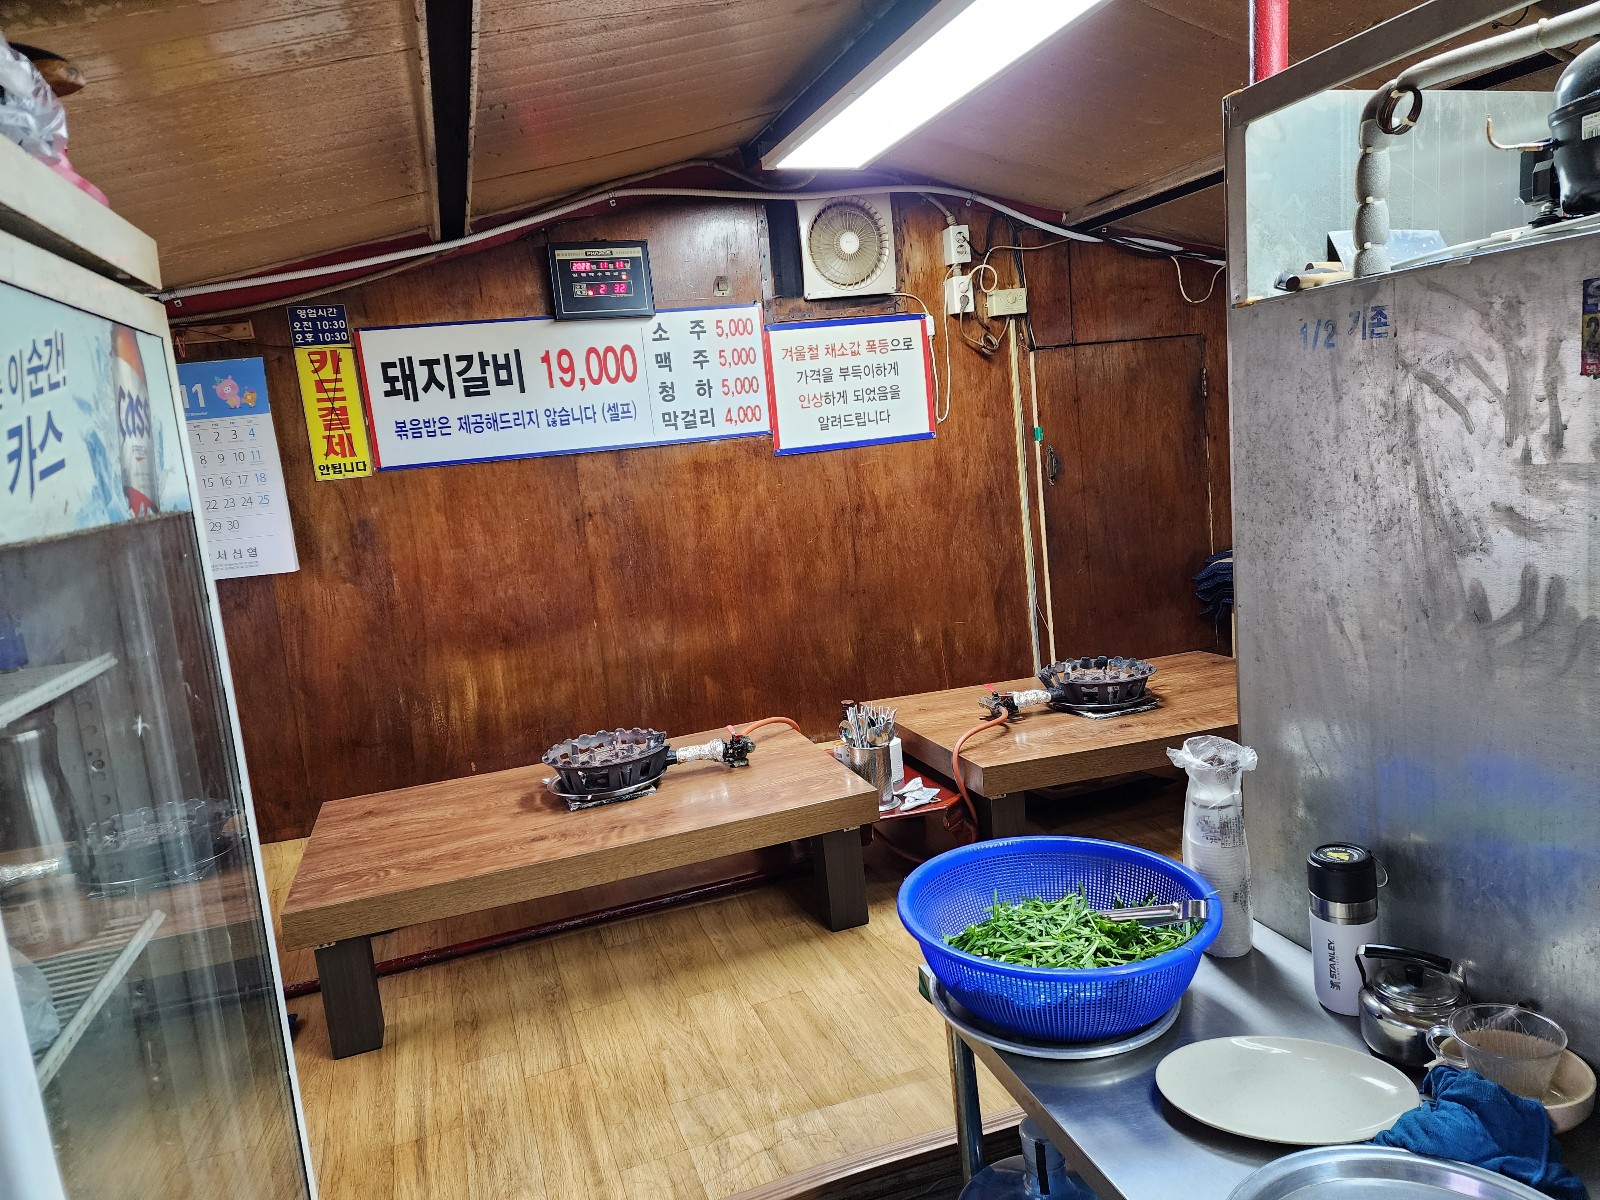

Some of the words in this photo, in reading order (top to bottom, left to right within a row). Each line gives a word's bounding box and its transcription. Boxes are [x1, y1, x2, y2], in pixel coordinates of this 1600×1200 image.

[600, 284, 606, 294] 2
[614, 284, 626, 293] 32
[297, 308, 337, 318] 영업시간
[294, 322, 312, 331] 오전
[316, 320, 346, 330] 10:30
[716, 318, 754, 339] 5,000
[1300, 319, 1337, 351] 1/2
[1348, 304, 1390, 340] 기존
[296, 333, 314, 342] 오후
[318, 332, 348, 341] 10:30
[718, 347, 756, 368] 5,000
[781, 344, 820, 362] 겨울철
[824, 341, 862, 358] 채소값
[866, 337, 915, 354] 폭등으로
[8, 330, 66, 404] 이순간!
[380, 348, 526, 402] 돼지갈비
[540, 344, 638, 392] 19,000
[797, 367, 834, 385] 가격을
[838, 361, 899, 381] 부득이하게
[722, 376, 760, 398] 5,000
[799, 390, 848, 409] 인상하게
[853, 384, 901, 404] 되었음을
[308, 350, 356, 458] 카드결제
[394, 416, 452, 440] 볶음밥은
[457, 409, 540, 434] 제공해드리지
[544, 404, 597, 428] 않습니다
[602, 400, 638, 424] (셀프)
[662, 408, 716, 431] 막걸리
[725, 405, 762, 426] 4,000
[818, 409, 892, 431] 알려드립니다
[196, 433, 202, 442] 1
[214, 432, 220, 441] 2
[231, 430, 237, 439] 3
[249, 428, 255, 437] 4
[7, 410, 66, 502] 카스
[200, 455, 207, 464] 8
[218, 454, 224, 463] 9
[233, 452, 245, 462] 10
[250, 450, 261, 460] 11
[318, 461, 367, 476] 안됩니다
[202, 478, 213, 488] 15
[220, 476, 232, 486] 16
[237, 475, 249, 484] 17
[255, 473, 266, 483] 18
[205, 500, 218, 510] 22
[224, 498, 236, 508] 23
[242, 497, 253, 506] 24
[258, 495, 270, 504] 25
[209, 522, 221, 531] 29
[227, 520, 239, 530] 30
[1328, 939, 1337, 979] STANLEY
